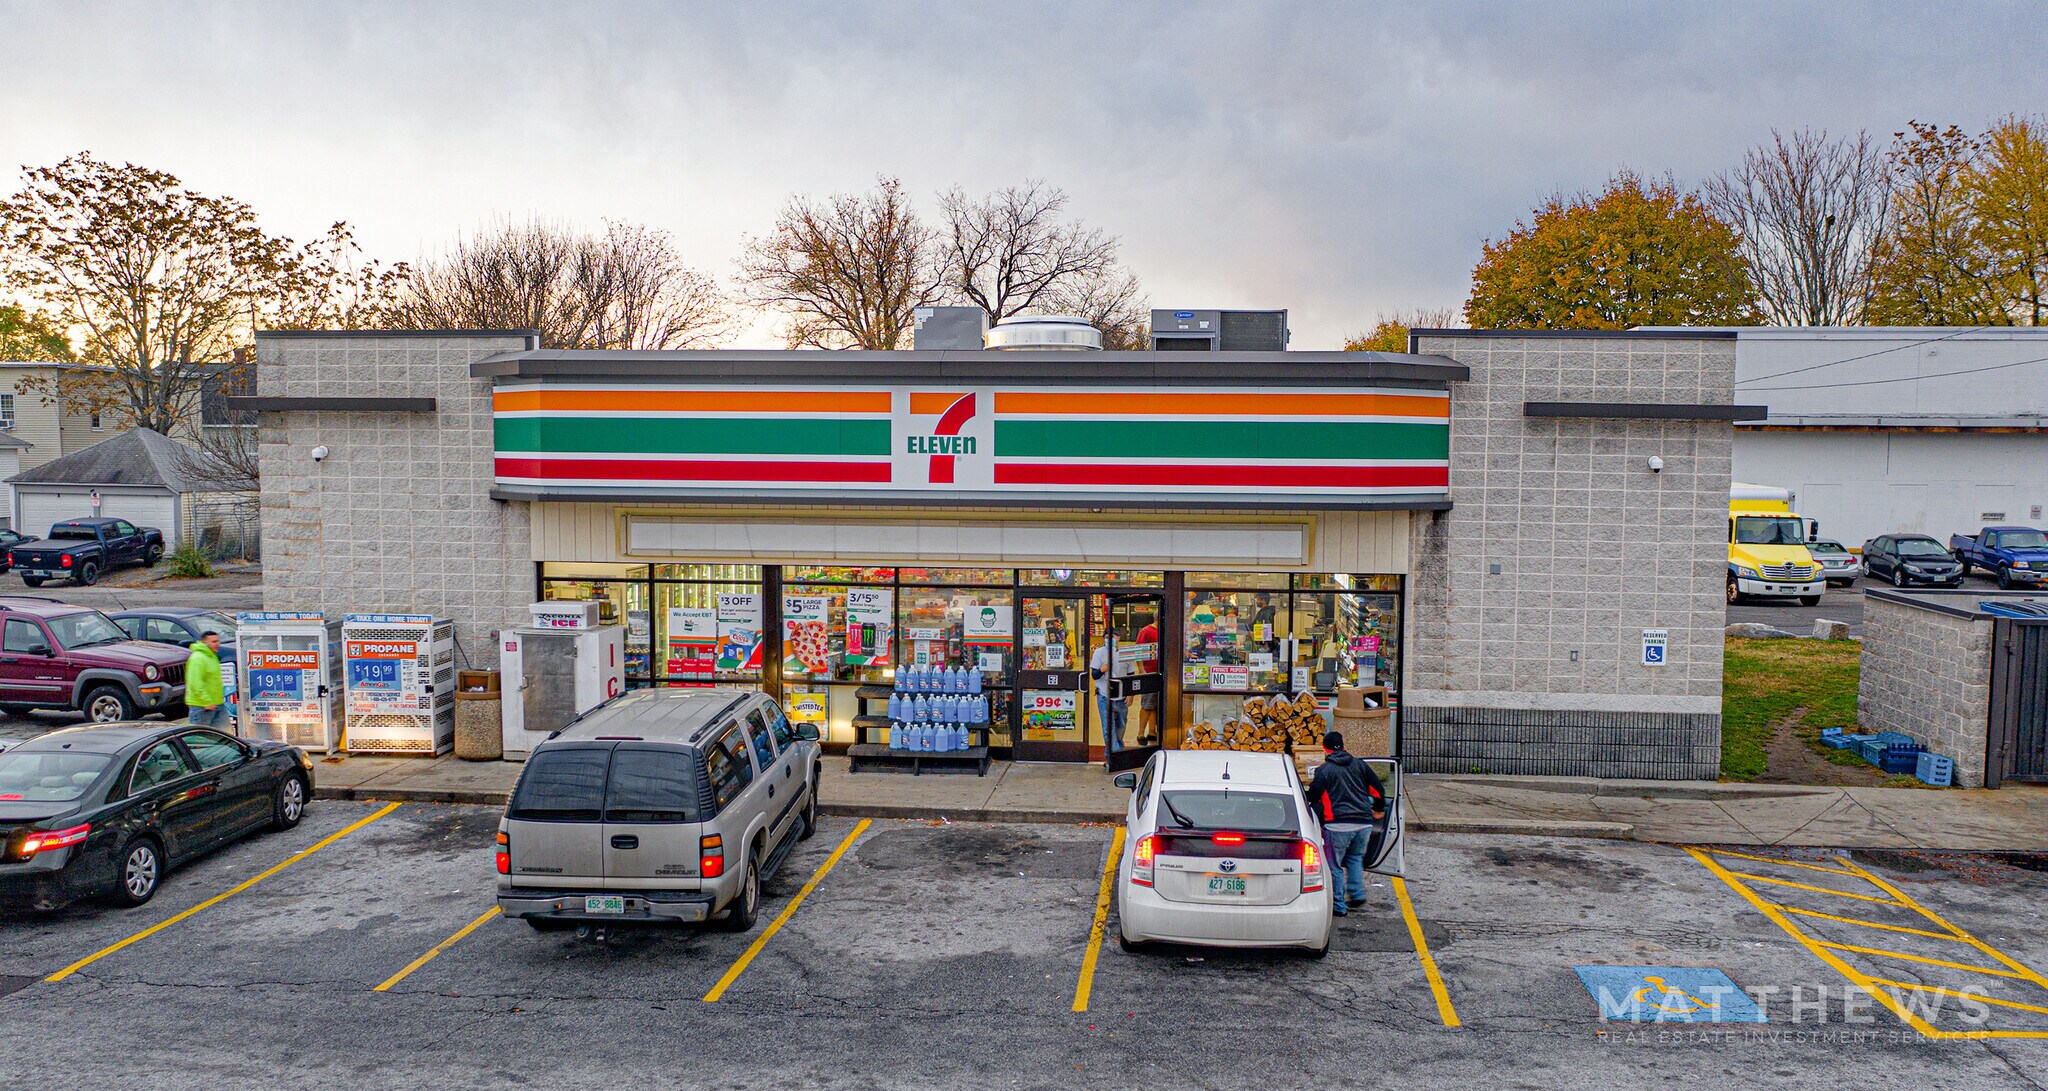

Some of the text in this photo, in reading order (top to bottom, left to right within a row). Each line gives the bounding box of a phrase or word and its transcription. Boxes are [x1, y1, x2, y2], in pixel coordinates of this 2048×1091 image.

[910, 392, 976, 483] 7
[732, 597, 752, 605] OFF
[786, 599, 802, 613] $5
[364, 645, 414, 653] PROPANE
[266, 655, 316, 663] PROPANE
[1213, 674, 1225, 684] NO
[1036, 697, 1061, 708] 99¢
[793, 703, 824, 712] TWISTED TEA
[1209, 879, 1245, 890] 427 6186
[588, 900, 622, 909] 452 8846
